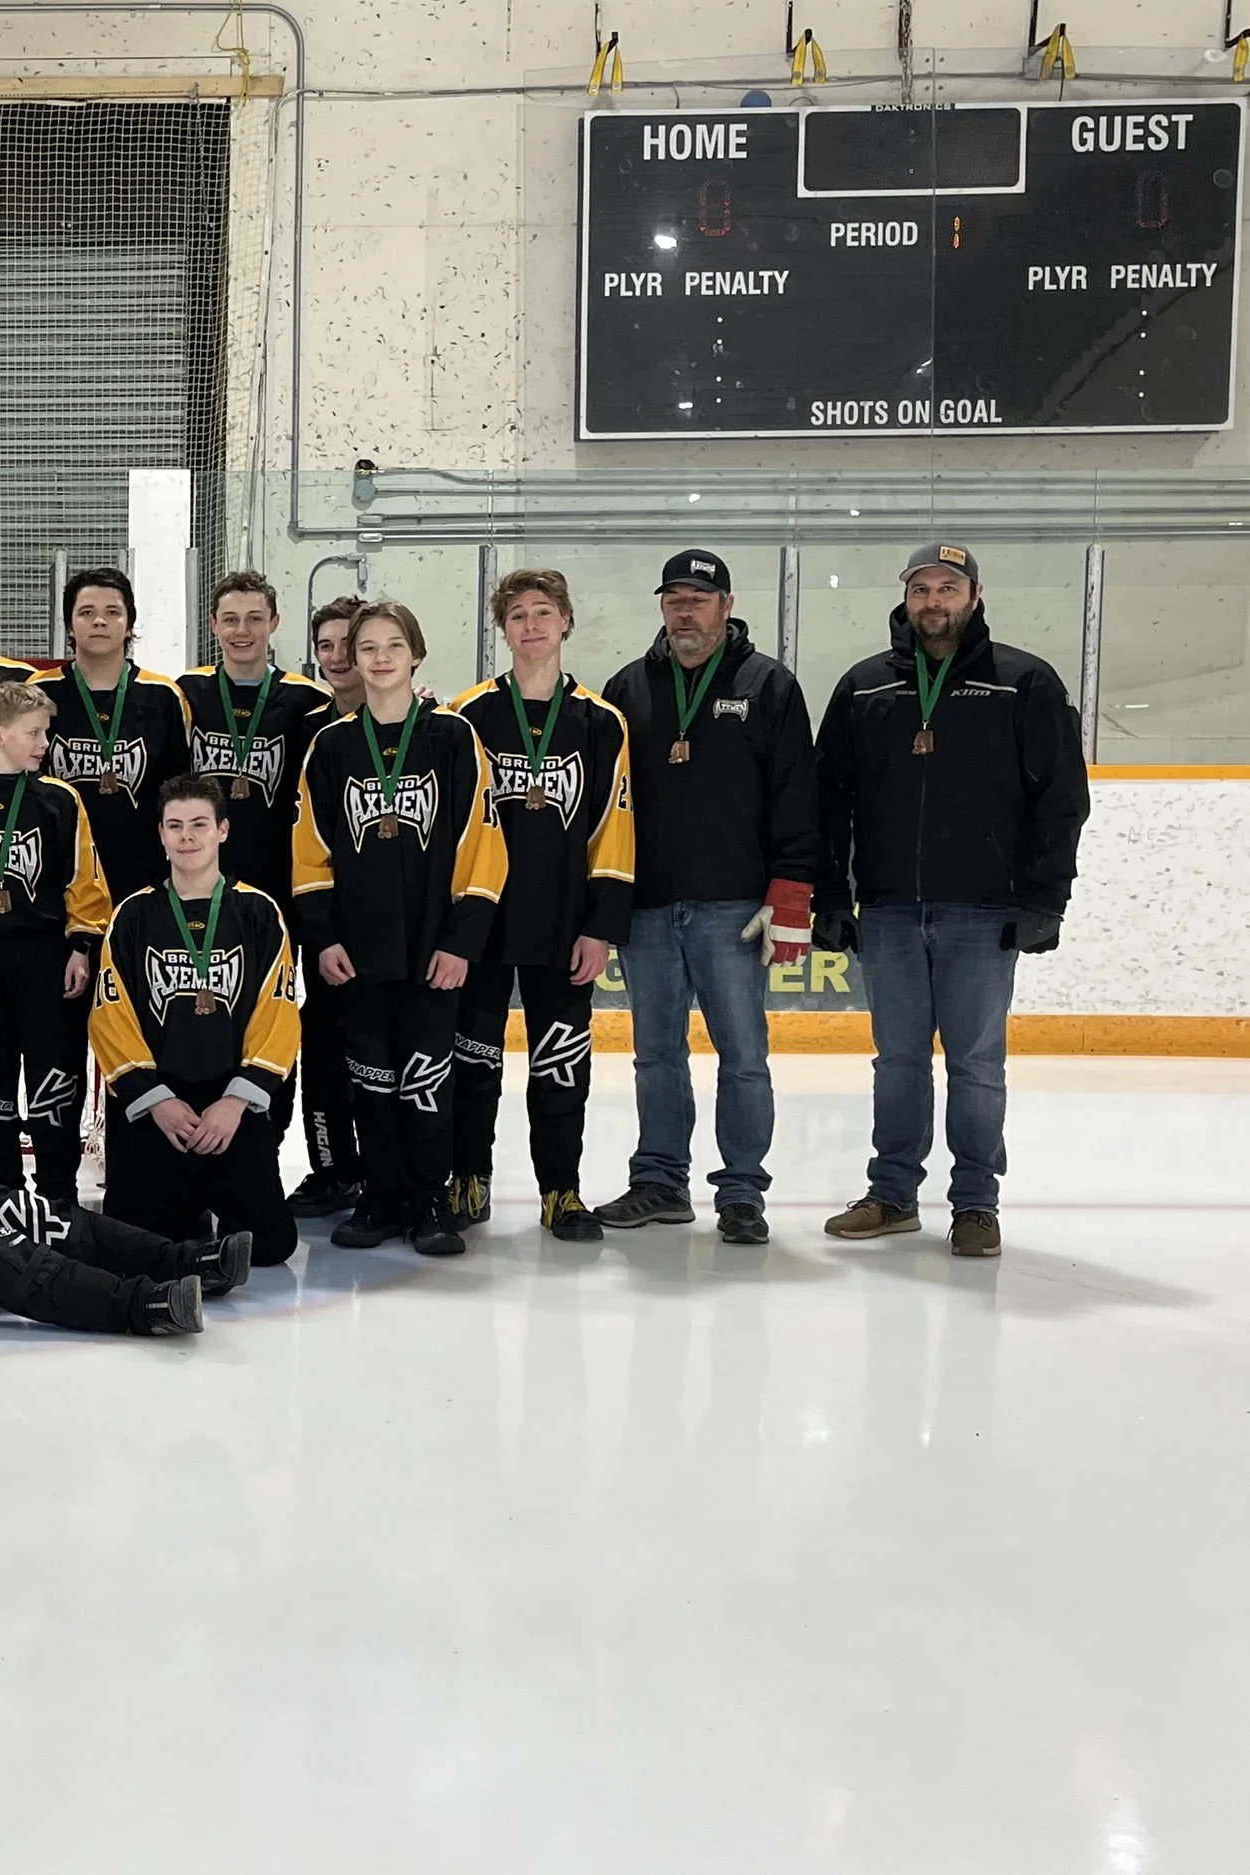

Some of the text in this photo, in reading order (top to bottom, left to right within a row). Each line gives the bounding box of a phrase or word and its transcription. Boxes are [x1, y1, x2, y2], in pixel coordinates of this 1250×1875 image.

[642, 123, 748, 161] HOME
[1071, 113, 1194, 153] GUEST
[829, 221, 919, 247] PERIOD
[604, 270, 790, 297] PLYR PENALTY
[1027, 263, 1218, 290] PLYR PENALTY
[810, 399, 1003, 426] SHOTS ON GOAL
[271, 961, 296, 1004] 18
[313, 1111, 334, 1167] HAGAN
